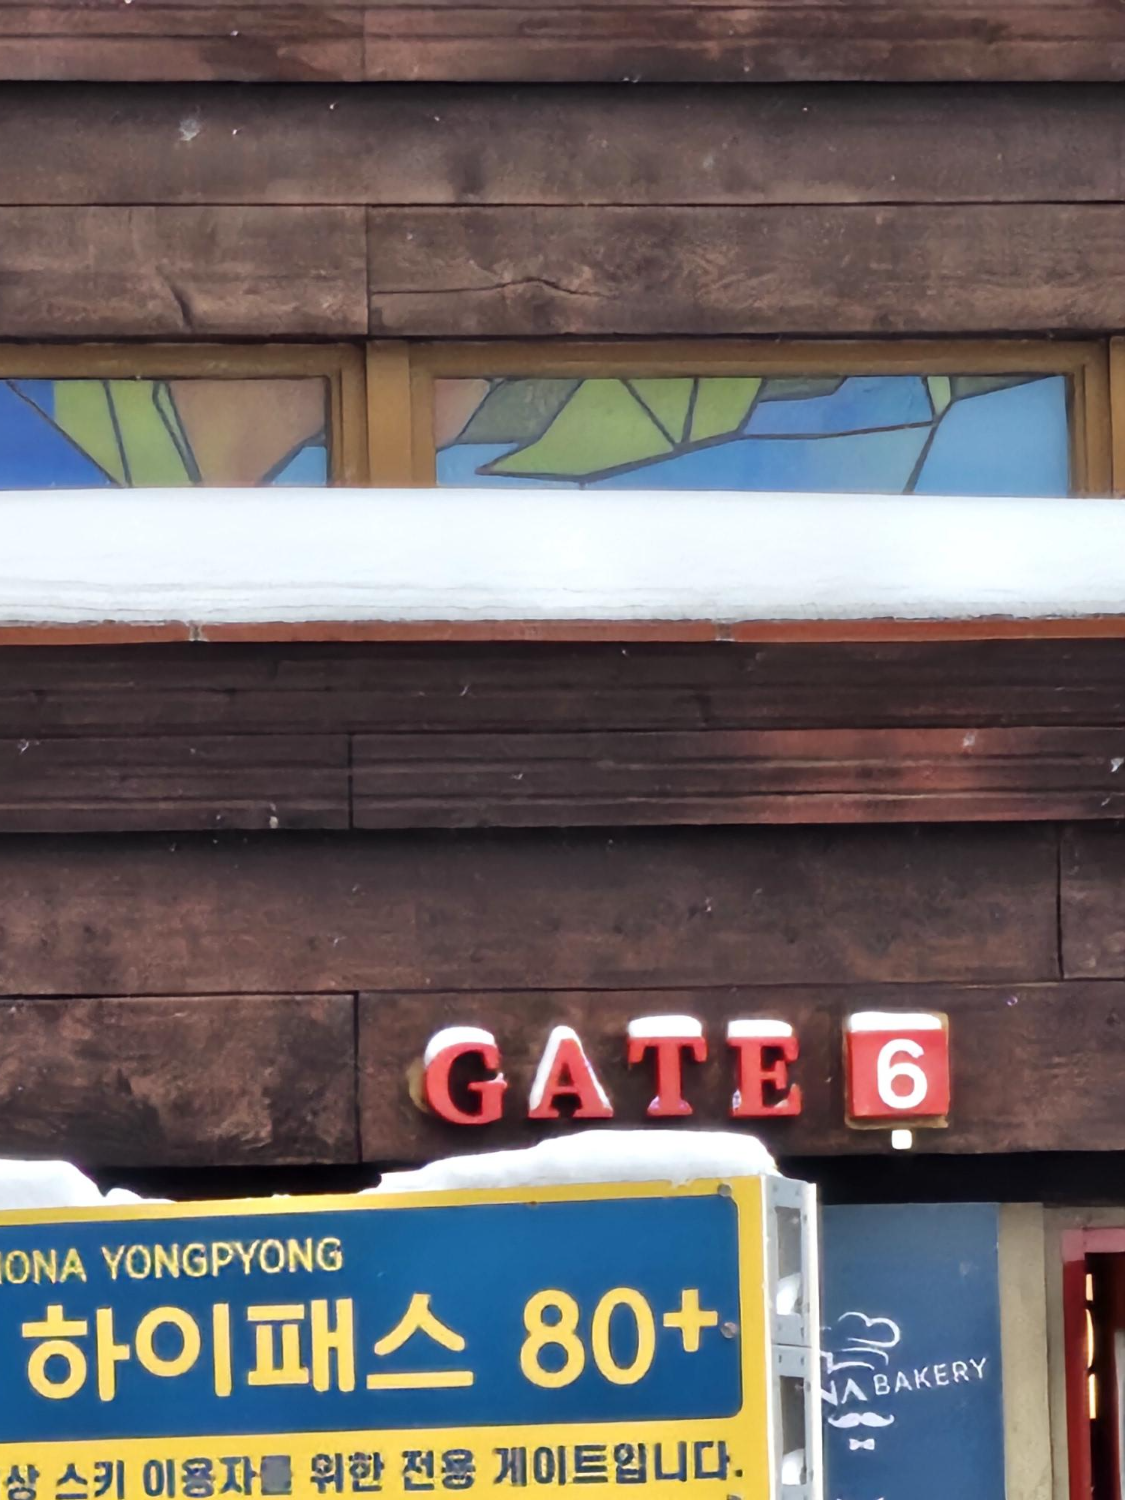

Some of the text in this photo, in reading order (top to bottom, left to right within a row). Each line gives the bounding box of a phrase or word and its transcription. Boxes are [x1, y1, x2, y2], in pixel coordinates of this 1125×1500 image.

[425, 1016, 929, 1124] GATE 6
[101, 1237, 343, 1281] YONGPYONG
[21, 1293, 475, 1402] 하이패스
[520, 1286, 719, 1388] 80+
[873, 1356, 988, 1396] BAKERY
[55, 1460, 126, 1500] 스키
[309, 1452, 385, 1493] 위한
[401, 1448, 476, 1492] 전용
[492, 1440, 744, 1487] 게이트입니다.
